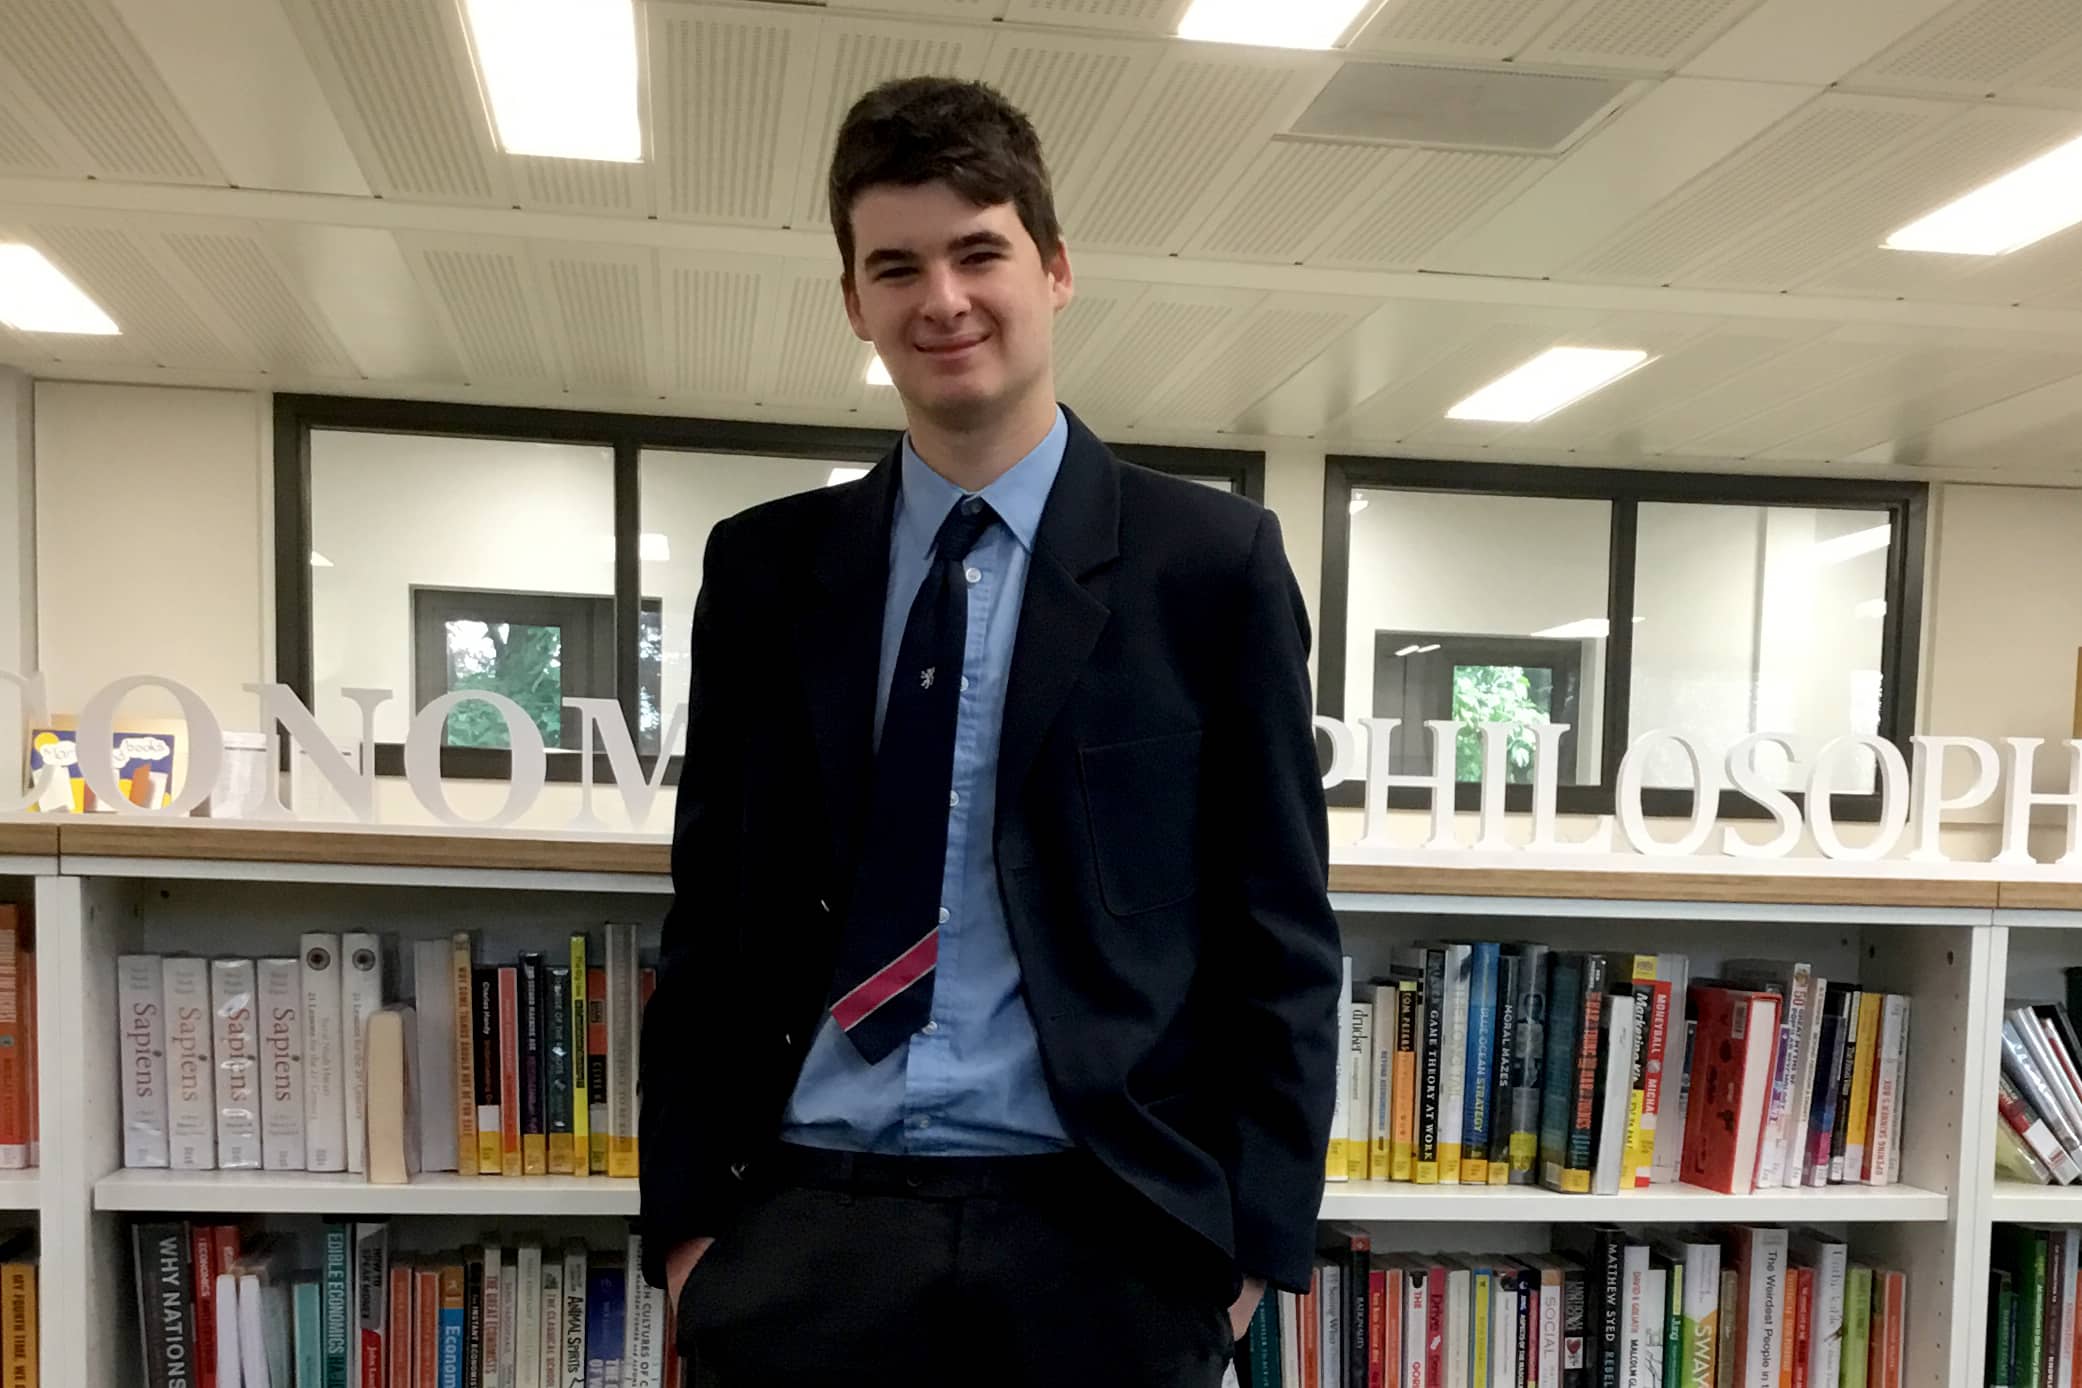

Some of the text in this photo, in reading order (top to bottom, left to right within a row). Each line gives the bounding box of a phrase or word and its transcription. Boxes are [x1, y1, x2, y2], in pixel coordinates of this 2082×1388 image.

[482, 982, 490, 1010] Charles
[1793, 990, 1805, 1006] 50
[481, 1011, 491, 1035] Handy
[1351, 1010, 1367, 1053] drucker
[1401, 1017, 1411, 1051] PETERS
[1428, 1010, 1438, 1046] GAME
[1631, 992, 1649, 1083] Marketing Kit
[127, 1003, 158, 1098] Sapiens
[172, 1007, 202, 1102] Sapiens
[221, 1008, 251, 1102] Sapiens
[266, 1007, 296, 1102] Sapiens
[1498, 1004, 1512, 1087] MORAL MAZES
[1645, 993, 1667, 1117] MONEYBALL MICHA
[1426, 1051, 1437, 1100] THEORY
[1474, 1007, 1489, 1133] BLUE OCEAN STRATEGY
[1425, 1103, 1435, 1120] AT
[1424, 1123, 1434, 1160] WORK
[1874, 1141, 1886, 1175] OPENING
[197, 1242, 211, 1297] ECONOMICS
[327, 1233, 345, 1278] EDIBLE
[373, 1247, 383, 1287] HOW TO
[1606, 1243, 1618, 1305] MATTHEW
[12, 1274, 25, 1291] MY
[360, 1248, 371, 1320] SPEAK MONEY
[547, 1294, 556, 1308] THE
[1413, 1291, 1423, 1309] THE
[1632, 1271, 1642, 1294] DAVID
[12, 1294, 25, 1331] FOURTH
[160, 1236, 187, 1388] WHY NATIONS
[328, 1282, 346, 1354] ECONOMICS
[471, 1306, 479, 1341] INSTANT
[485, 1277, 498, 1374] THE GREAT ECONOMISTS
[567, 1296, 584, 1335] ANIMAL
[640, 1303, 652, 1357] CULTURES
[1356, 1296, 1364, 1349] RATIONALITY
[1430, 1294, 1443, 1331] Drive
[1543, 1296, 1556, 1359] SOCIAL
[1605, 1310, 1616, 1342] SYED
[1631, 1302, 1641, 1334] GOLIATH
[1670, 1318, 1681, 1340] Jung
[1760, 1250, 1778, 1381] The Weirdest People in
[546, 1311, 556, 1354] CLASSICAL
[14, 1365, 26, 1381] WE
[367, 1346, 378, 1367] John
[444, 1325, 461, 1388] Econom
[567, 1337, 582, 1374] SPIRITS
[589, 1359, 603, 1372] OF
[606, 1359, 620, 1382] THE
[640, 1361, 649, 1376] OF
[1629, 1338, 1639, 1376] MALCOLM
[1691, 1326, 1711, 1388] SWAY
